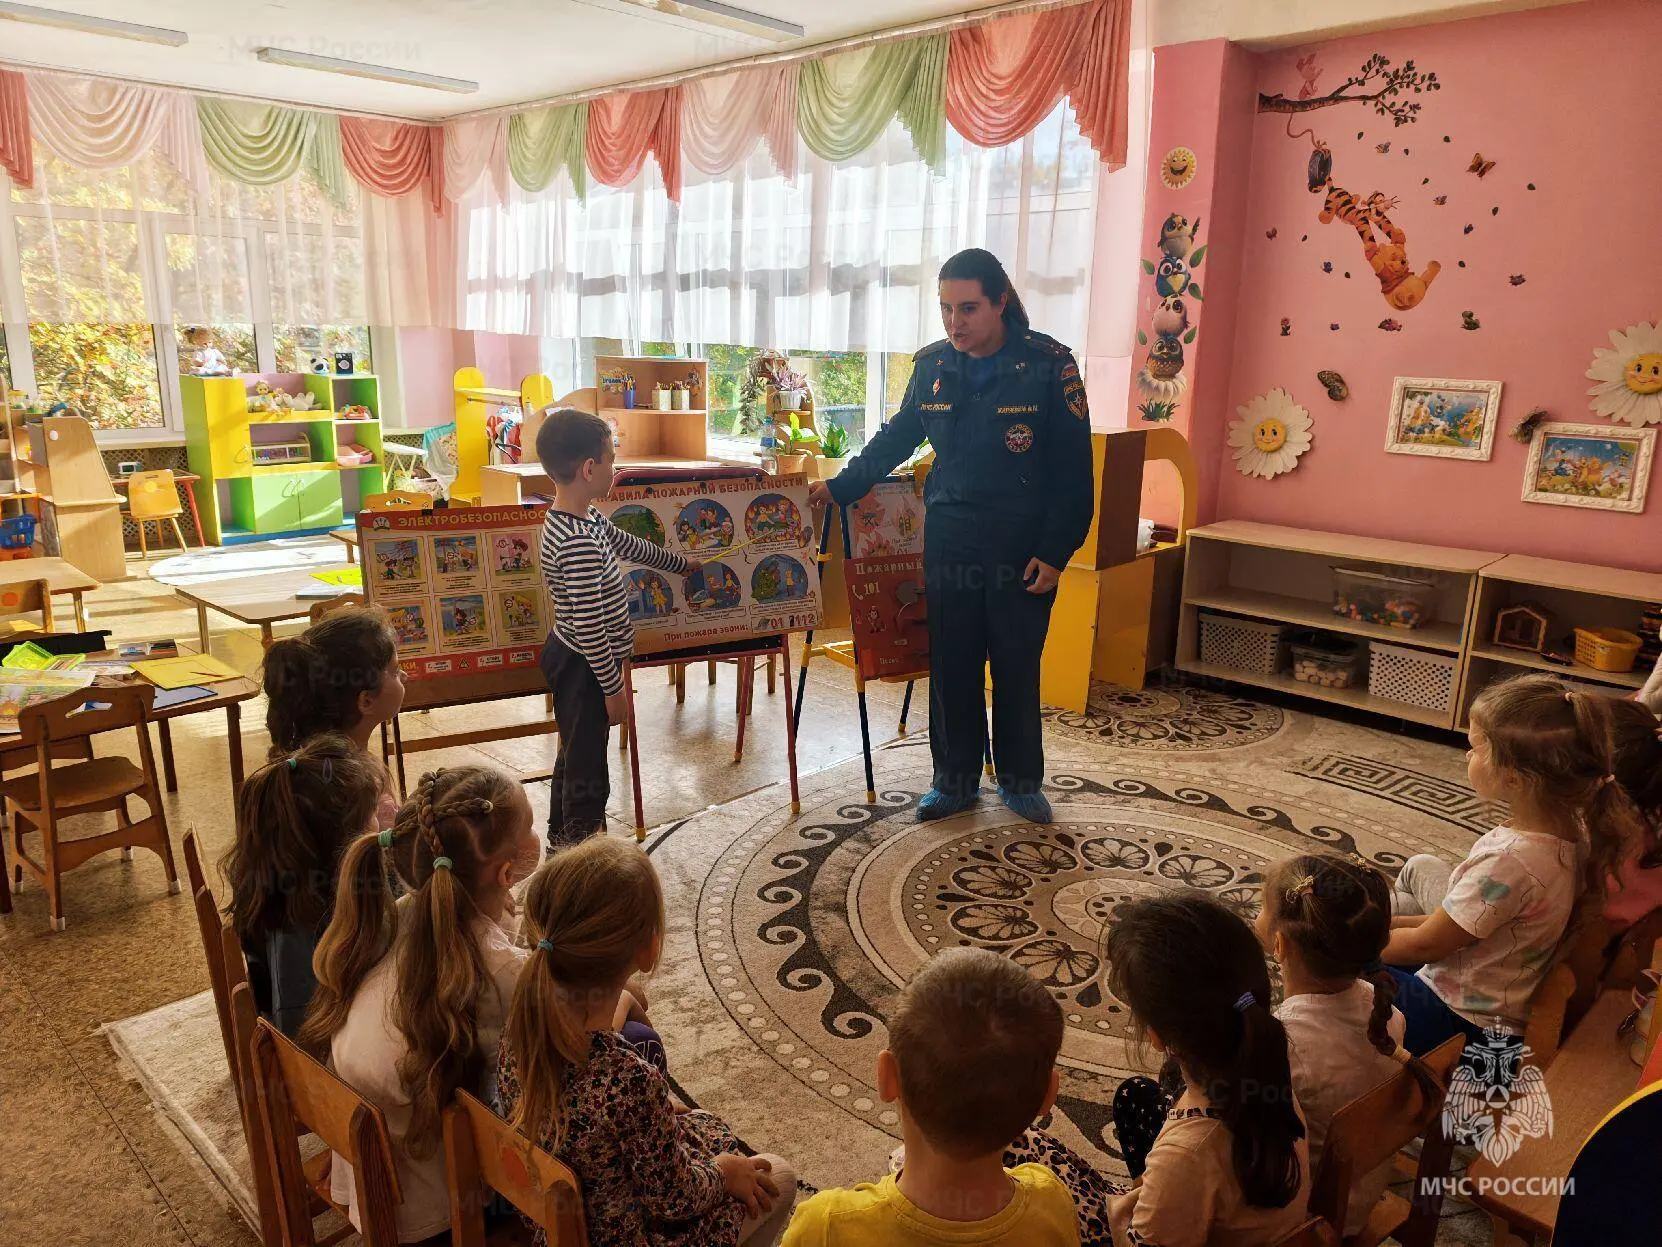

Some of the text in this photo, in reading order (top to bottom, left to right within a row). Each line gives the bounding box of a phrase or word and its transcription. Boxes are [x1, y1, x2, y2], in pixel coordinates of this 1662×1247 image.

[653, 482, 716, 499] ПОЖАРНОЙ
[719, 477, 803, 494] БЕЗОПАСНОСТИ
[398, 510, 547, 528] ЭЛЕКТРОБЕЗОПАСНОС
[664, 632, 681, 642] При
